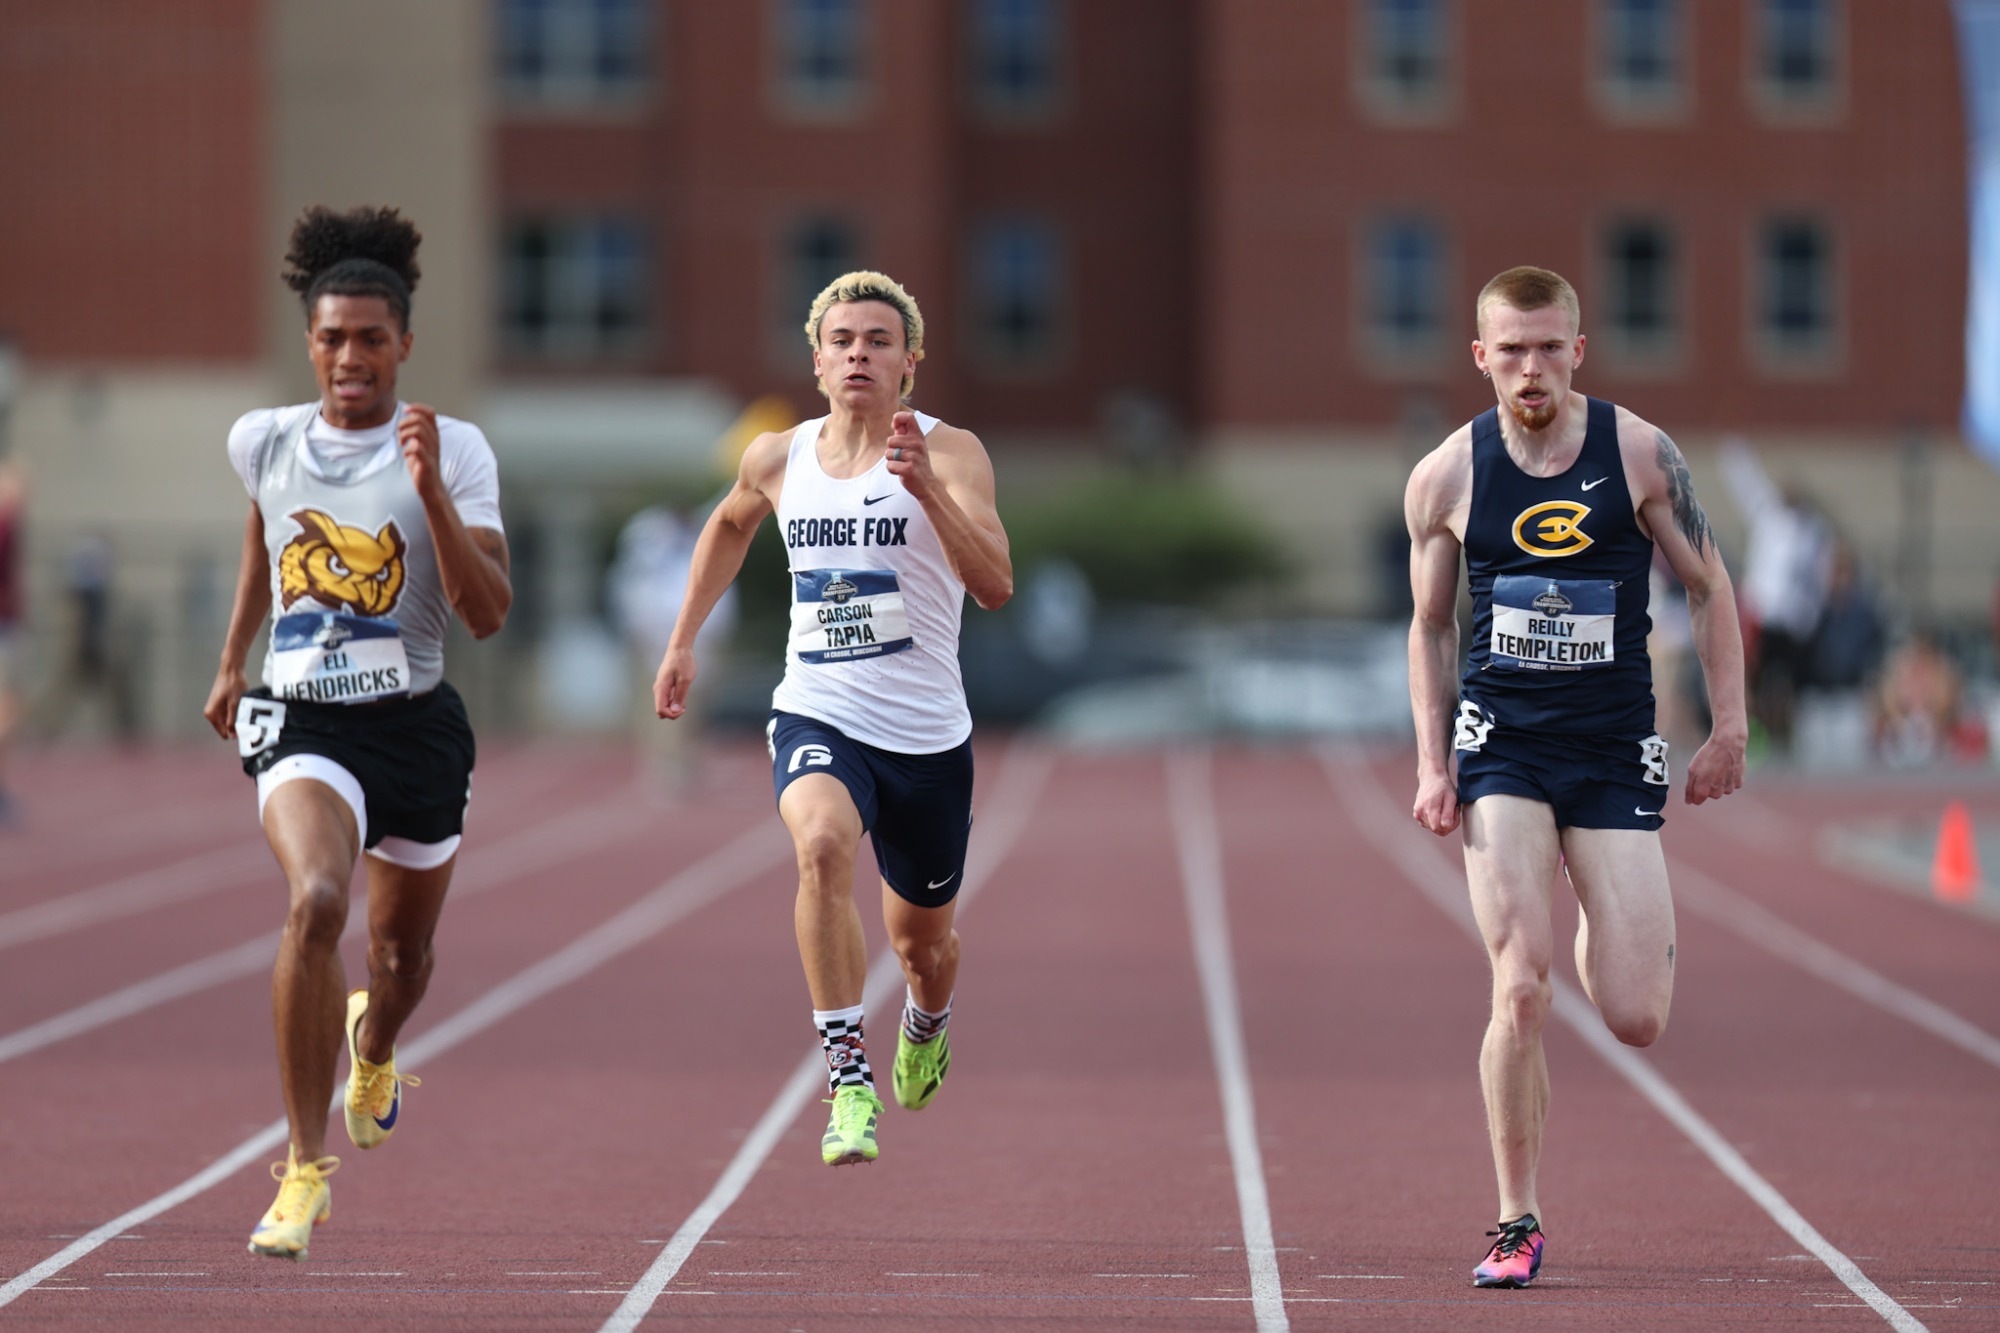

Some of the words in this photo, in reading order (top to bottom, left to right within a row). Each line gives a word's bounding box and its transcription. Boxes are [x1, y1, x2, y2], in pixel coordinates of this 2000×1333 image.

[788, 517, 857, 549] GEORGE
[863, 517, 908, 547] FOX
[817, 603, 873, 624] CARSON
[824, 623, 876, 648] TAPIA
[1528, 618, 1575, 638] REILLY
[1497, 632, 1606, 662] TEMPLETON
[323, 652, 348, 671] ELI
[283, 667, 400, 702] HENDRICKS
[249, 707, 273, 748] 5
